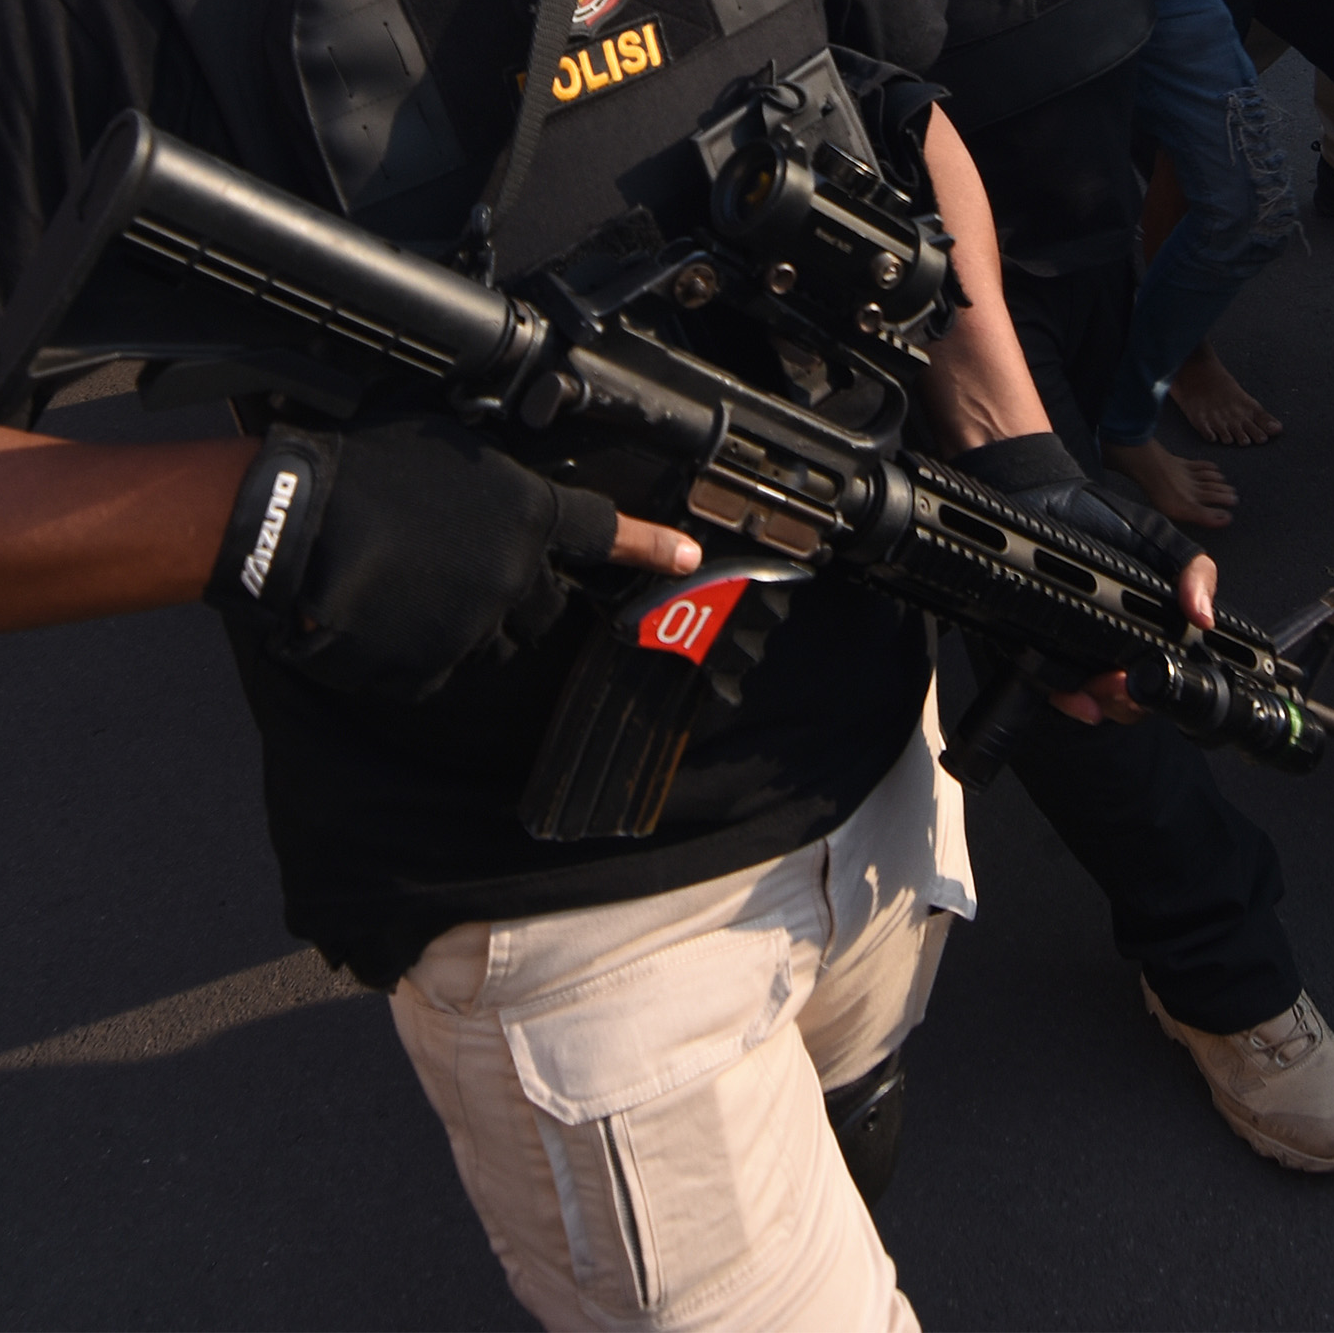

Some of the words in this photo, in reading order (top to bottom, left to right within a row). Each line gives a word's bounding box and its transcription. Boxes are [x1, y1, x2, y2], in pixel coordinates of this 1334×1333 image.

[517, 23, 663, 101] OLISI
[240, 470, 299, 599] MIZUNO
[657, 599, 713, 650] 01
